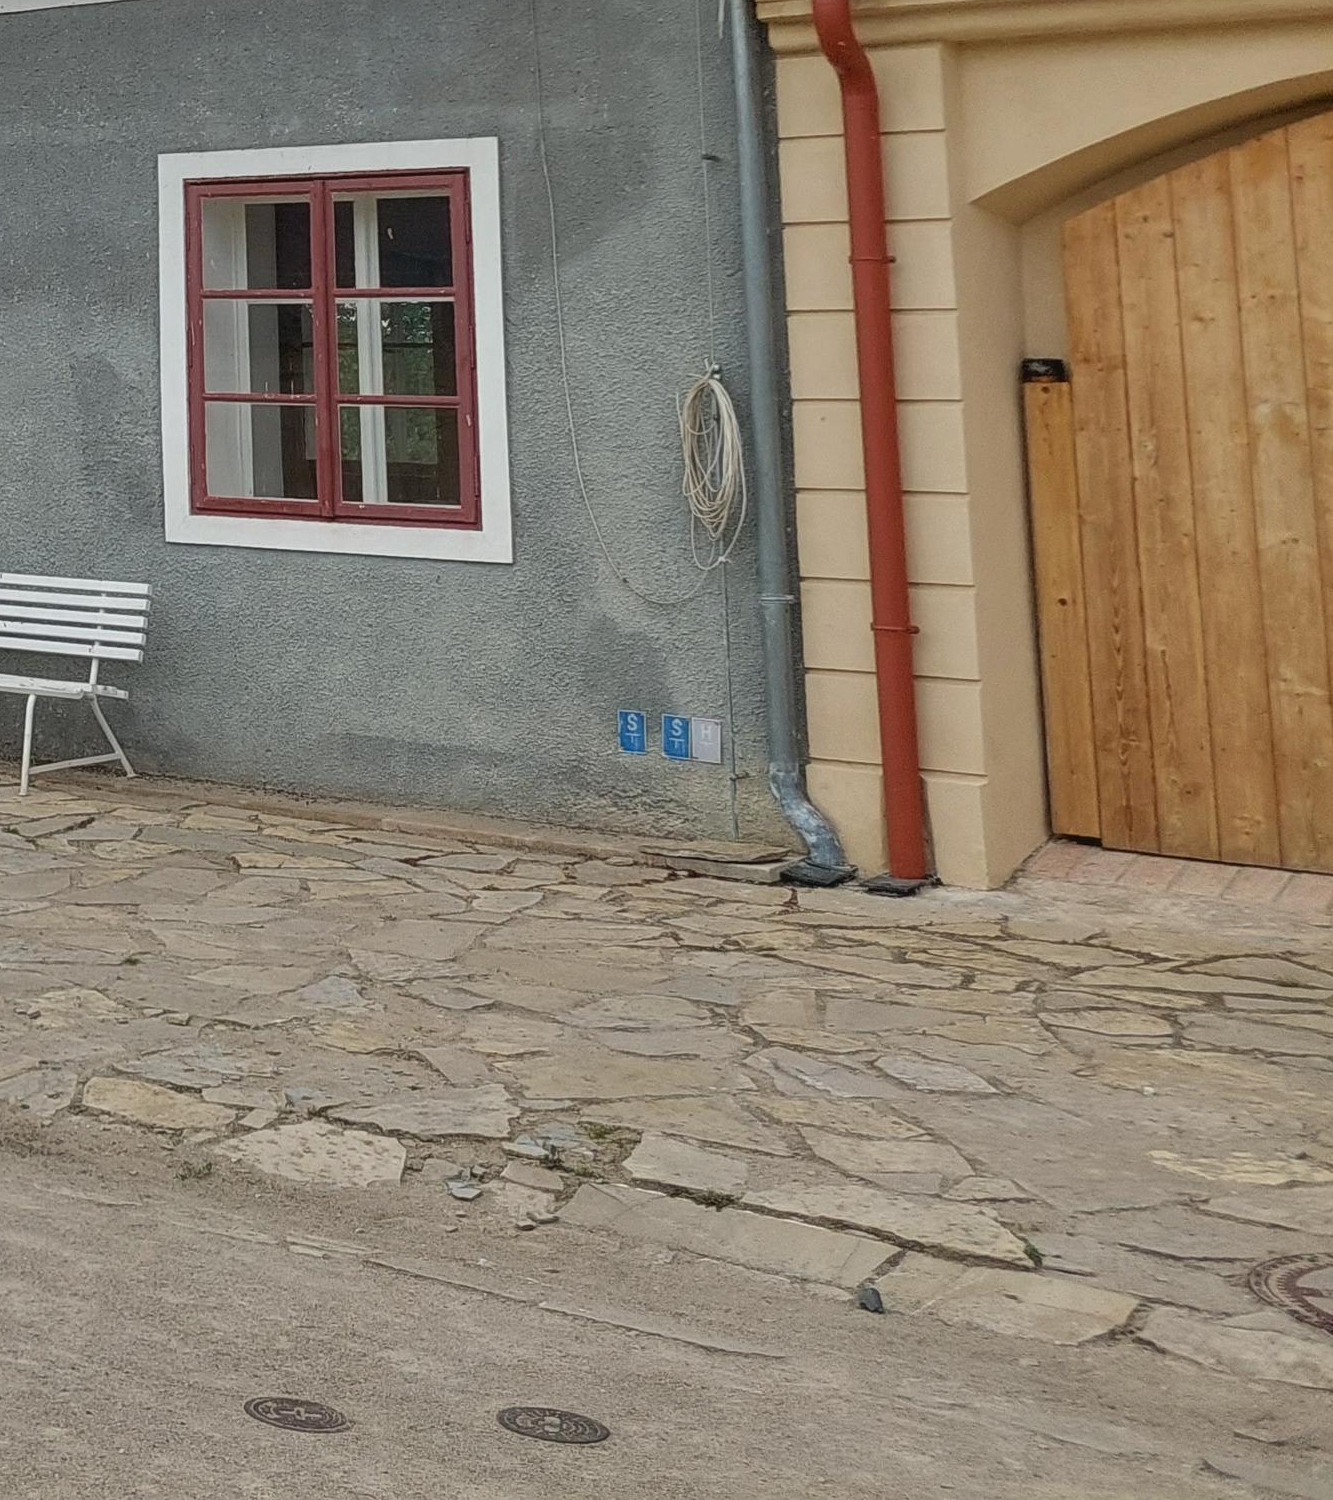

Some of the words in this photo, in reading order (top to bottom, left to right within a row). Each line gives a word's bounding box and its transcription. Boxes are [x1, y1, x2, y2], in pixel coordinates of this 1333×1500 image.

[627, 713, 638, 731] S
[671, 718, 682, 736] S
[700, 723, 712, 741] H
